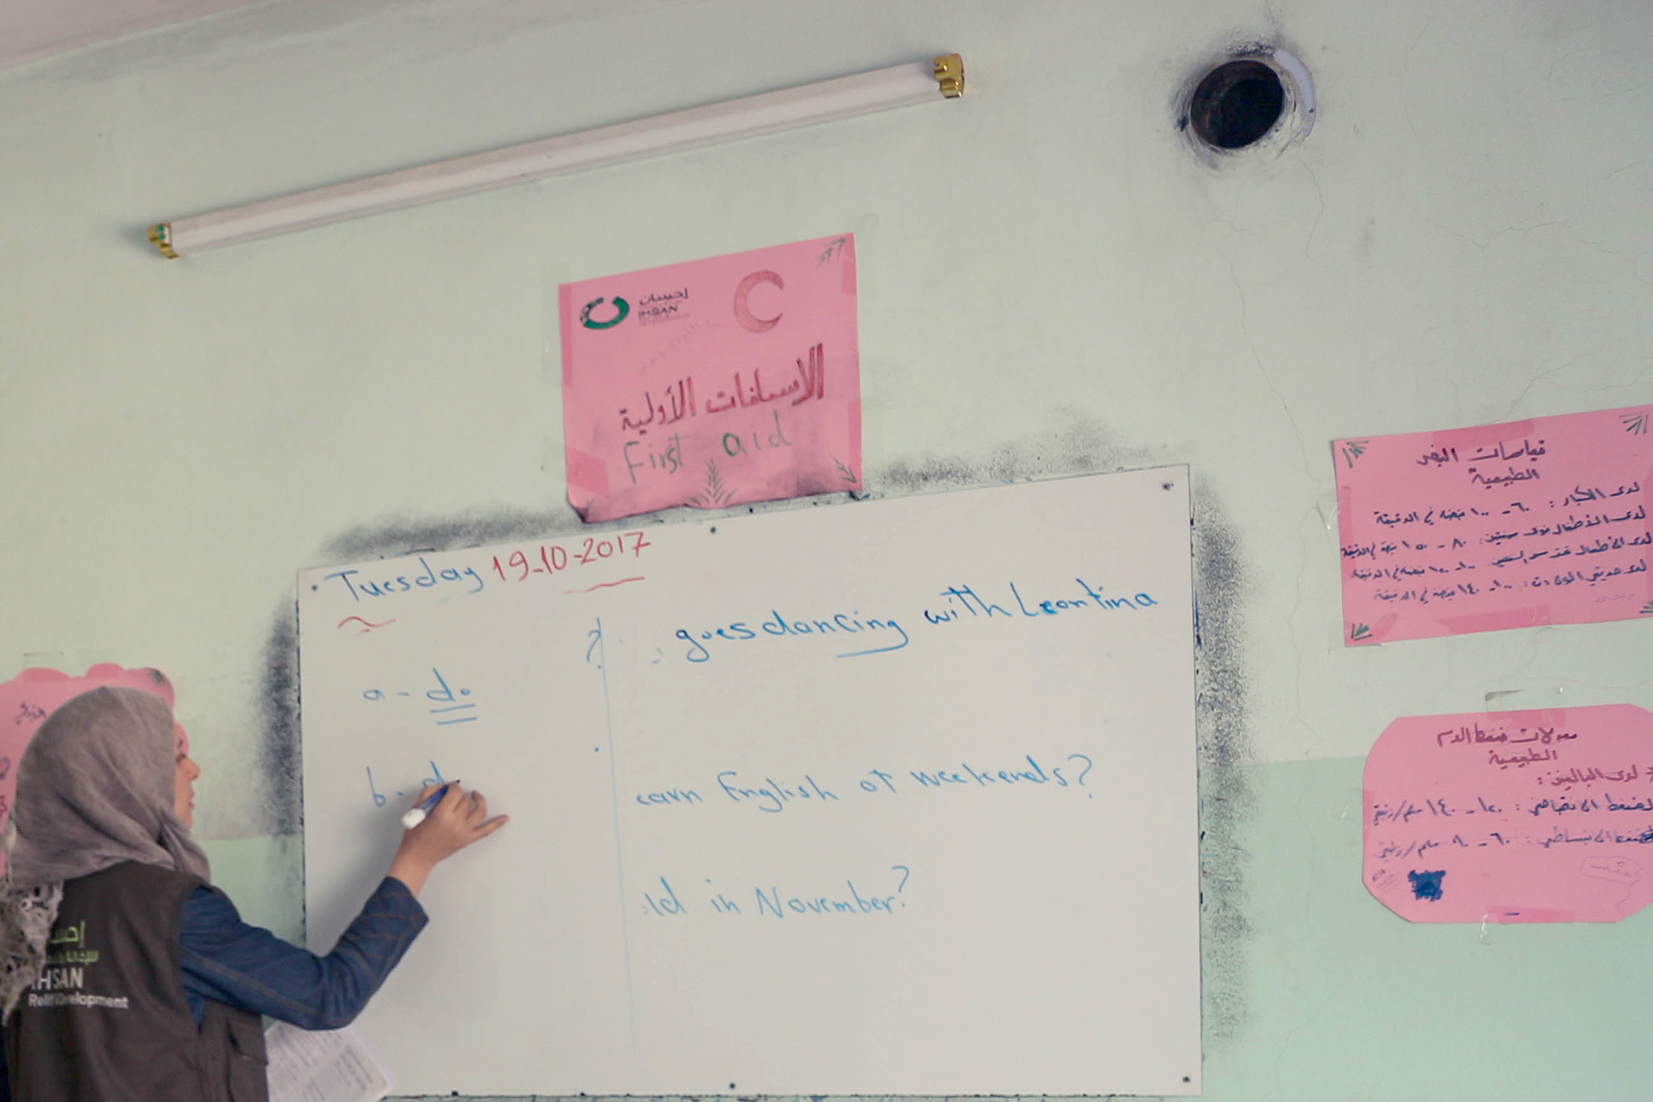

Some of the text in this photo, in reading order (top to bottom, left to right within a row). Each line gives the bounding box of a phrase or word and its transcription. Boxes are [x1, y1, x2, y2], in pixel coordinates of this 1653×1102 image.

[624, 432, 693, 484] First
[324, 557, 484, 602] Tuesday
[923, 583, 1013, 625] with
[717, 771, 839, 814] English
